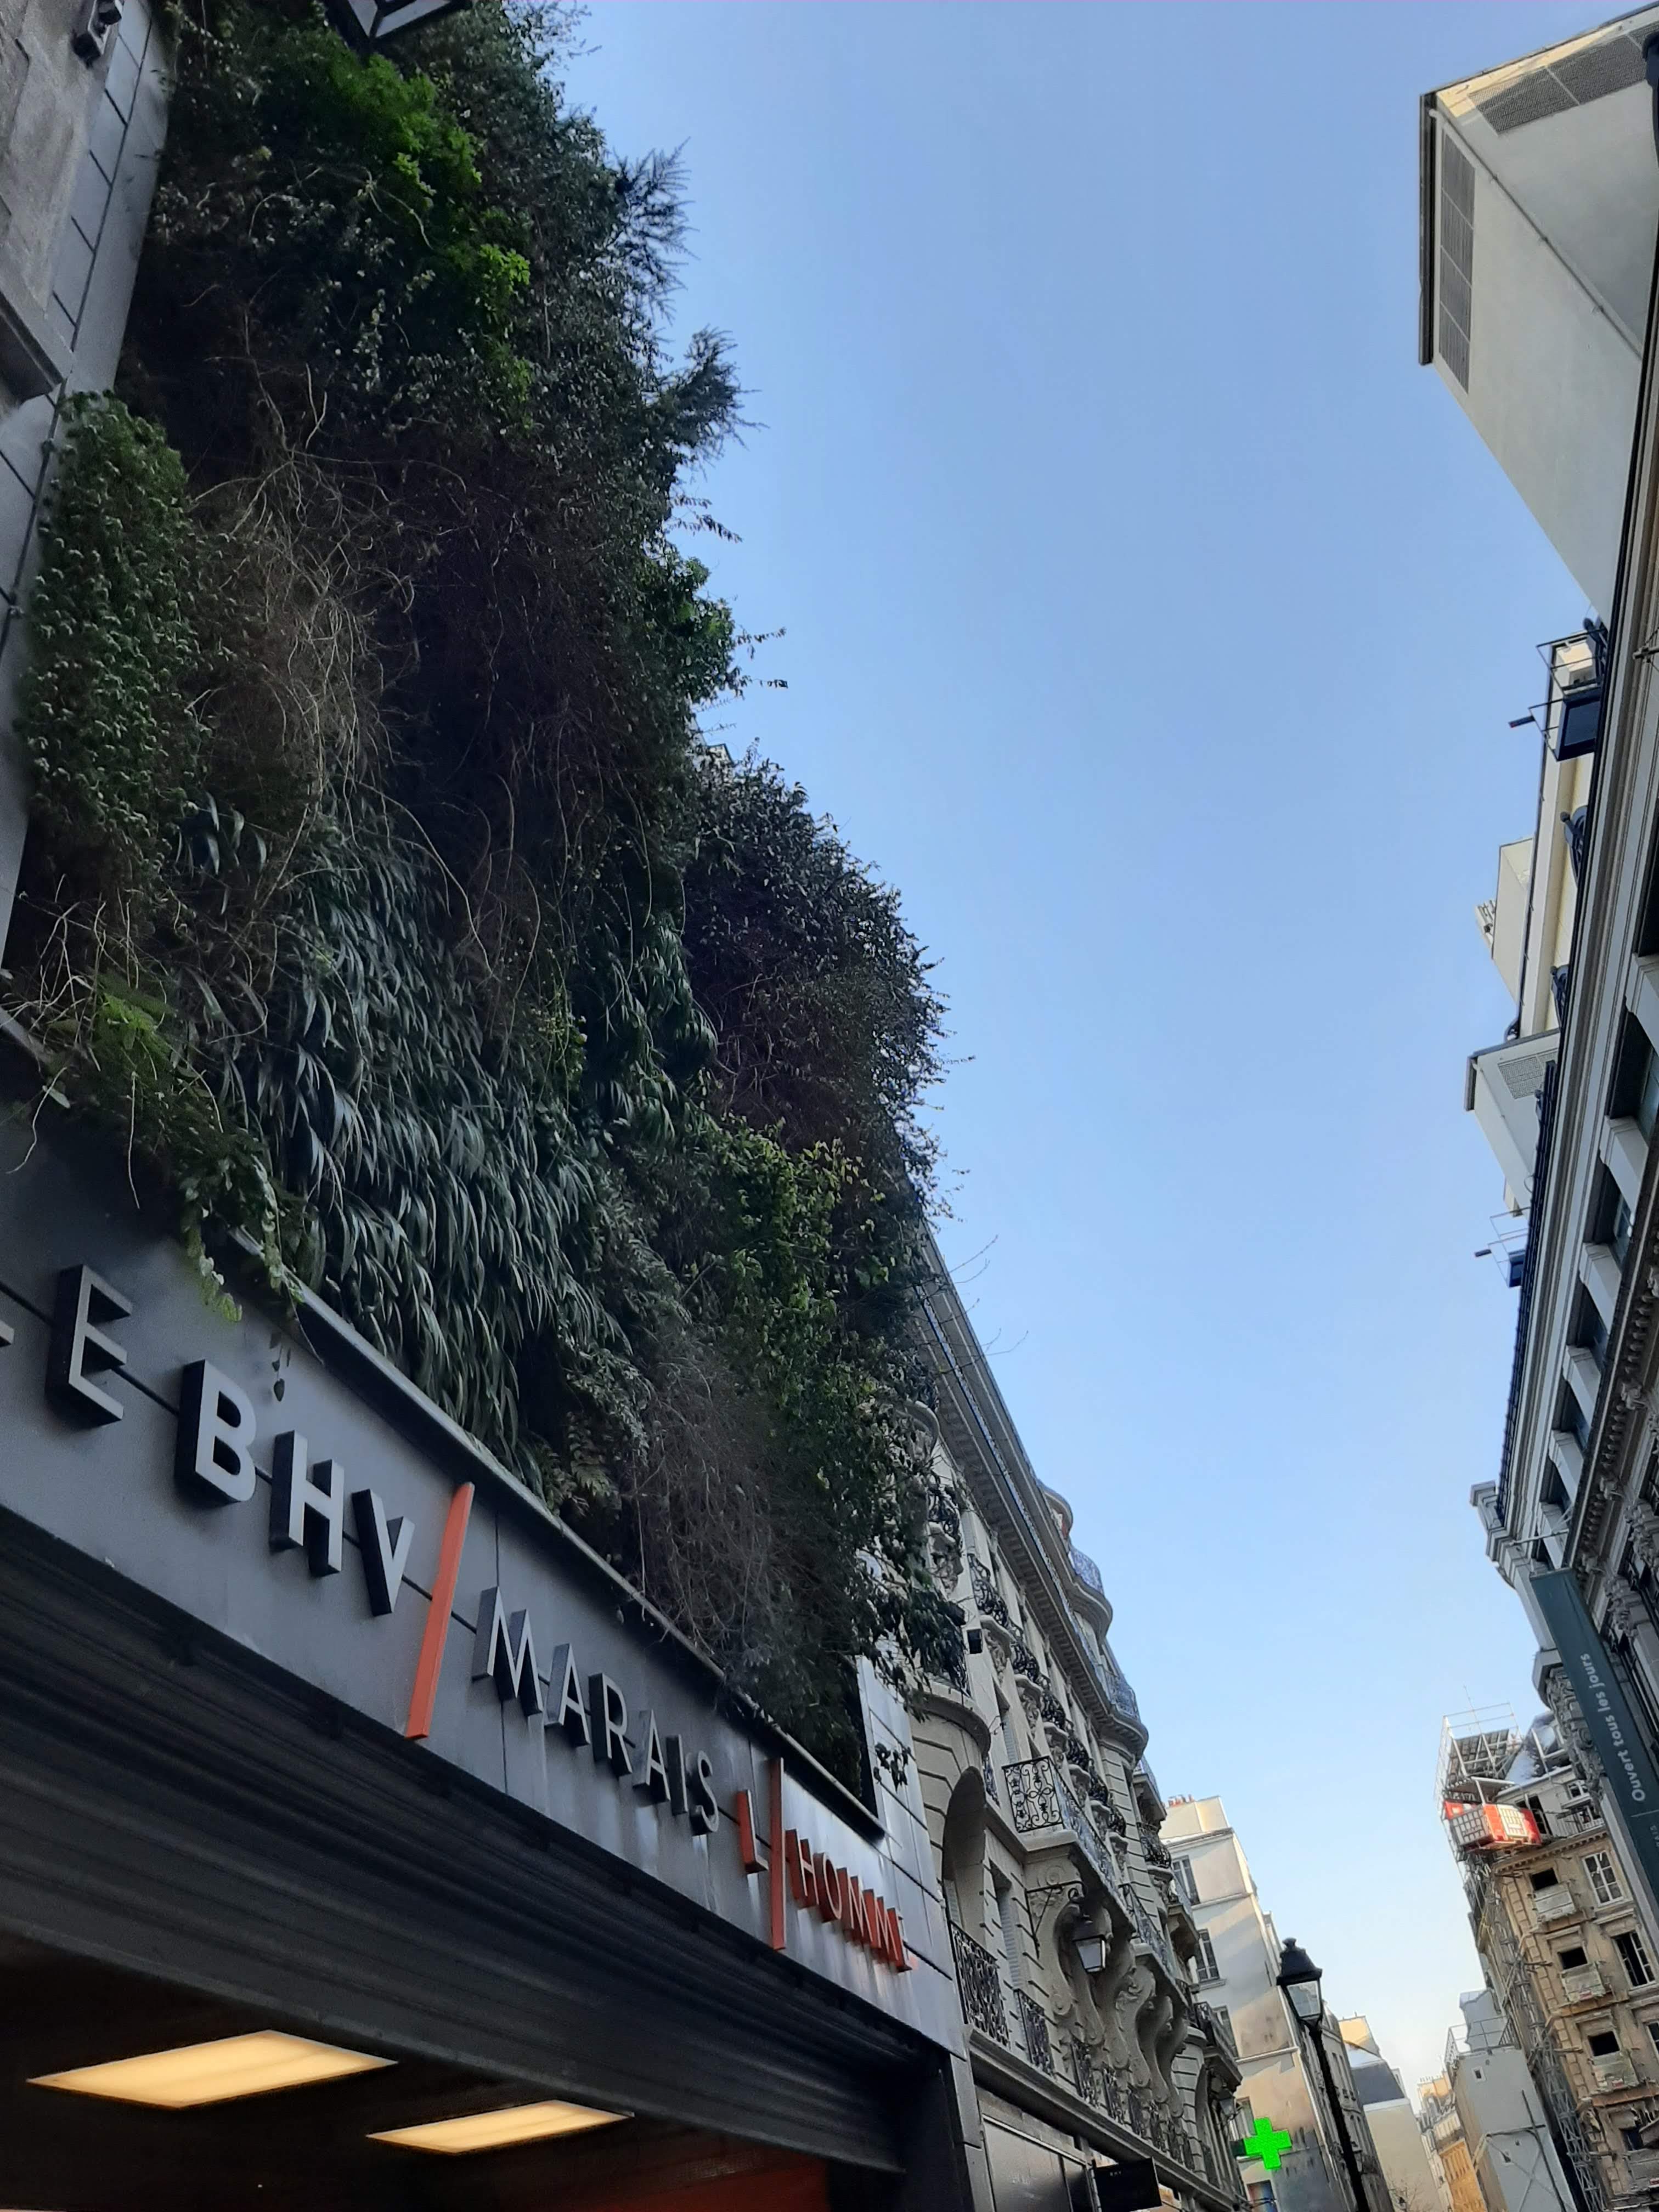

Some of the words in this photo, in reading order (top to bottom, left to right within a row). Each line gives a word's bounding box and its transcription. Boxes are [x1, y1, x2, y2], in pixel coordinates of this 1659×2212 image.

[0, 1264, 133, 1425] E
[1580, 1653, 1605, 1688] jours
[1596, 1691, 1611, 1712] les
[1605, 1714, 1623, 1747] tous
[1617, 1750, 1645, 1802] Ouvert
